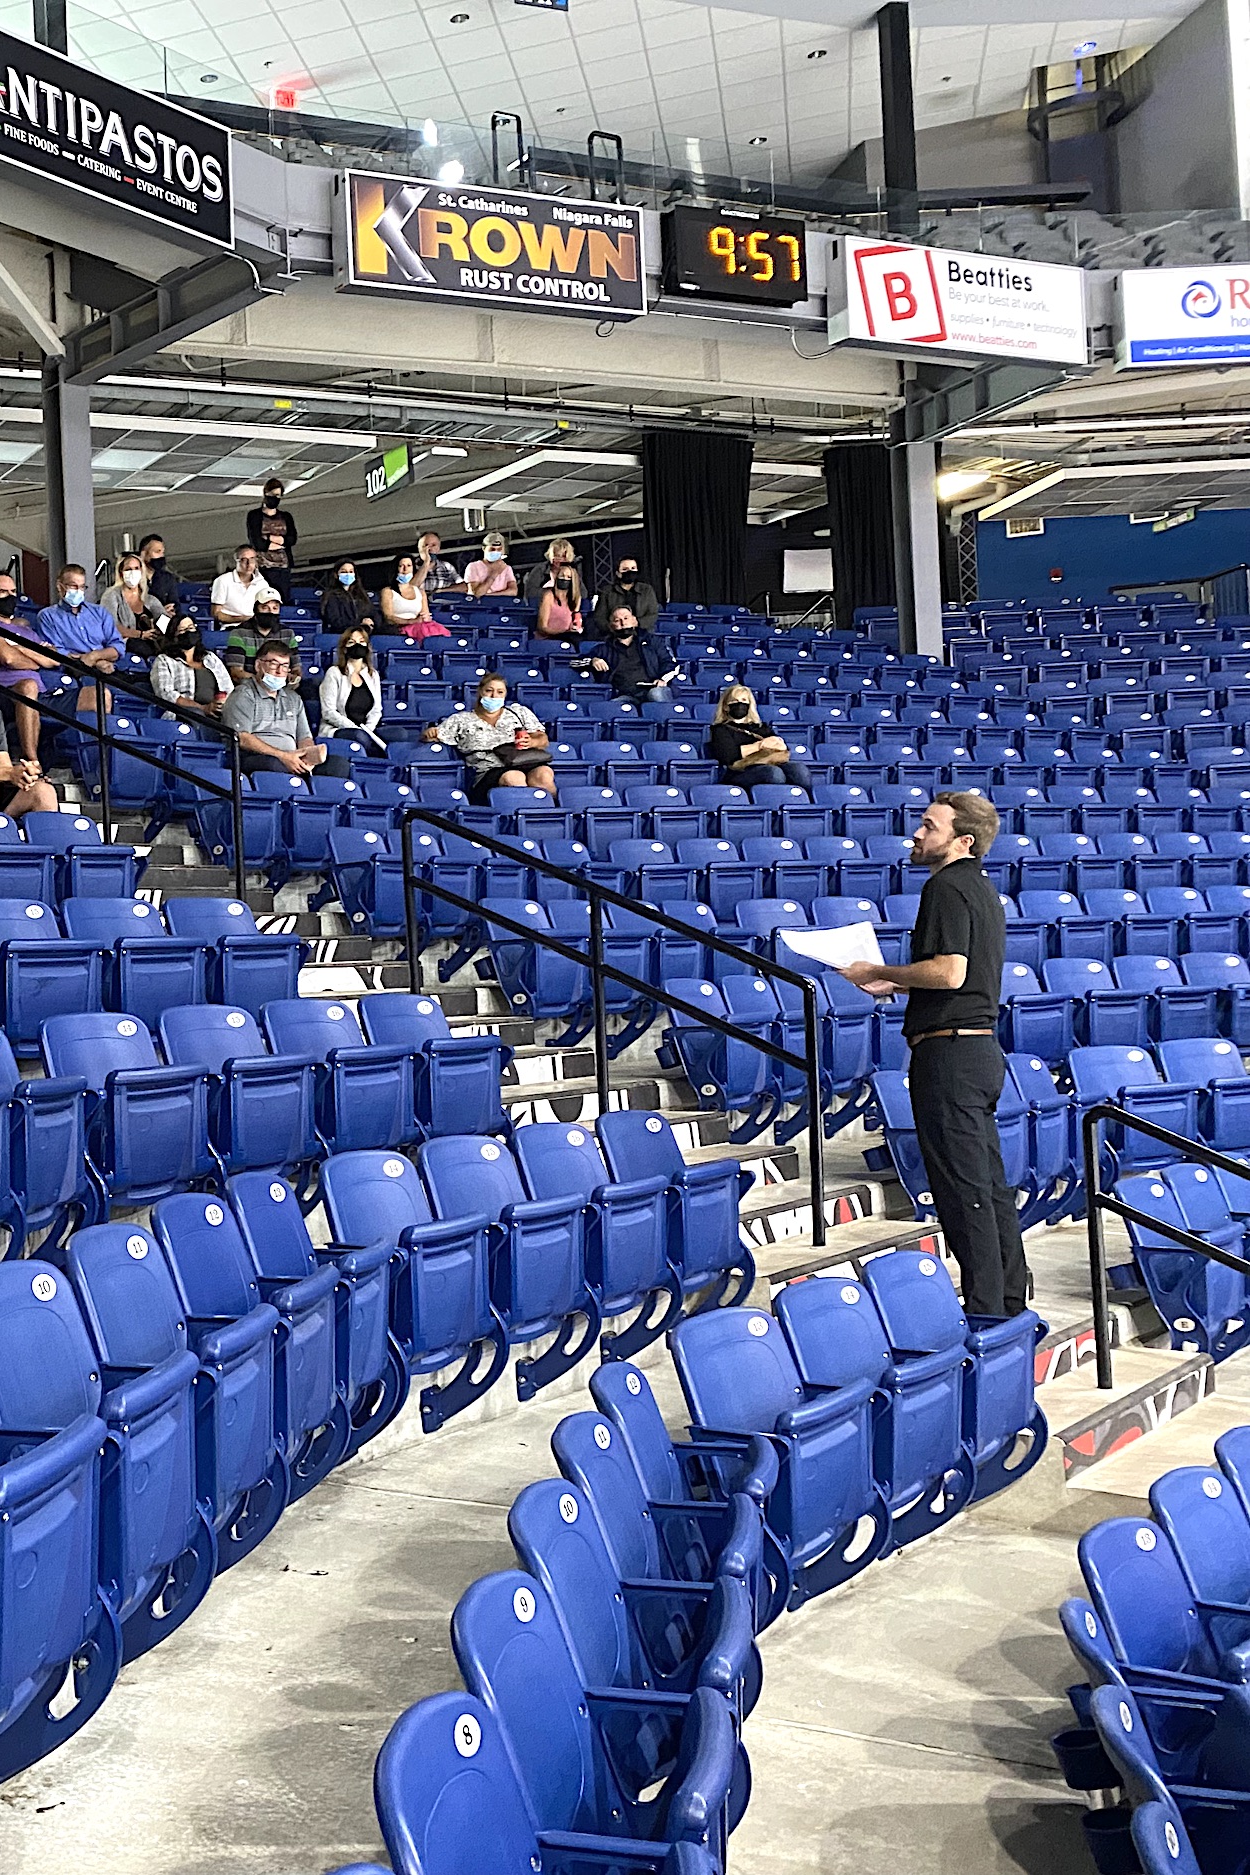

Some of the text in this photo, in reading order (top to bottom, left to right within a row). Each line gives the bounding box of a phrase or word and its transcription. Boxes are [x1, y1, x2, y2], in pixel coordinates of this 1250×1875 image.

[3, 123, 199, 214] FINE FOODS CATERING EVENT CENTRE
[438, 192, 528, 217] St. Catharines
[552, 206, 634, 230] Niagara Falls
[354, 180, 638, 283] KROWN
[708, 226, 800, 282] 9:57
[460, 268, 611, 302] RUST CONTROL
[948, 260, 1033, 292] Beatties
[883, 271, 919, 322] B
[949, 287, 962, 300] Be
[964, 292, 986, 304] your
[988, 293, 1010, 307] best
[1011, 298, 1021, 309] at
[950, 313, 984, 325] supplies
[1034, 323, 1078, 338] technology
[1230, 315, 1250, 327] ho
[951, 332, 1038, 349] www.beatties.com
[365, 466, 387, 498] 102
[38, 1280, 51, 1295] 10
[563, 1500, 574, 1518] 10
[519, 1596, 529, 1613] 9
[462, 1724, 473, 1746] 8
